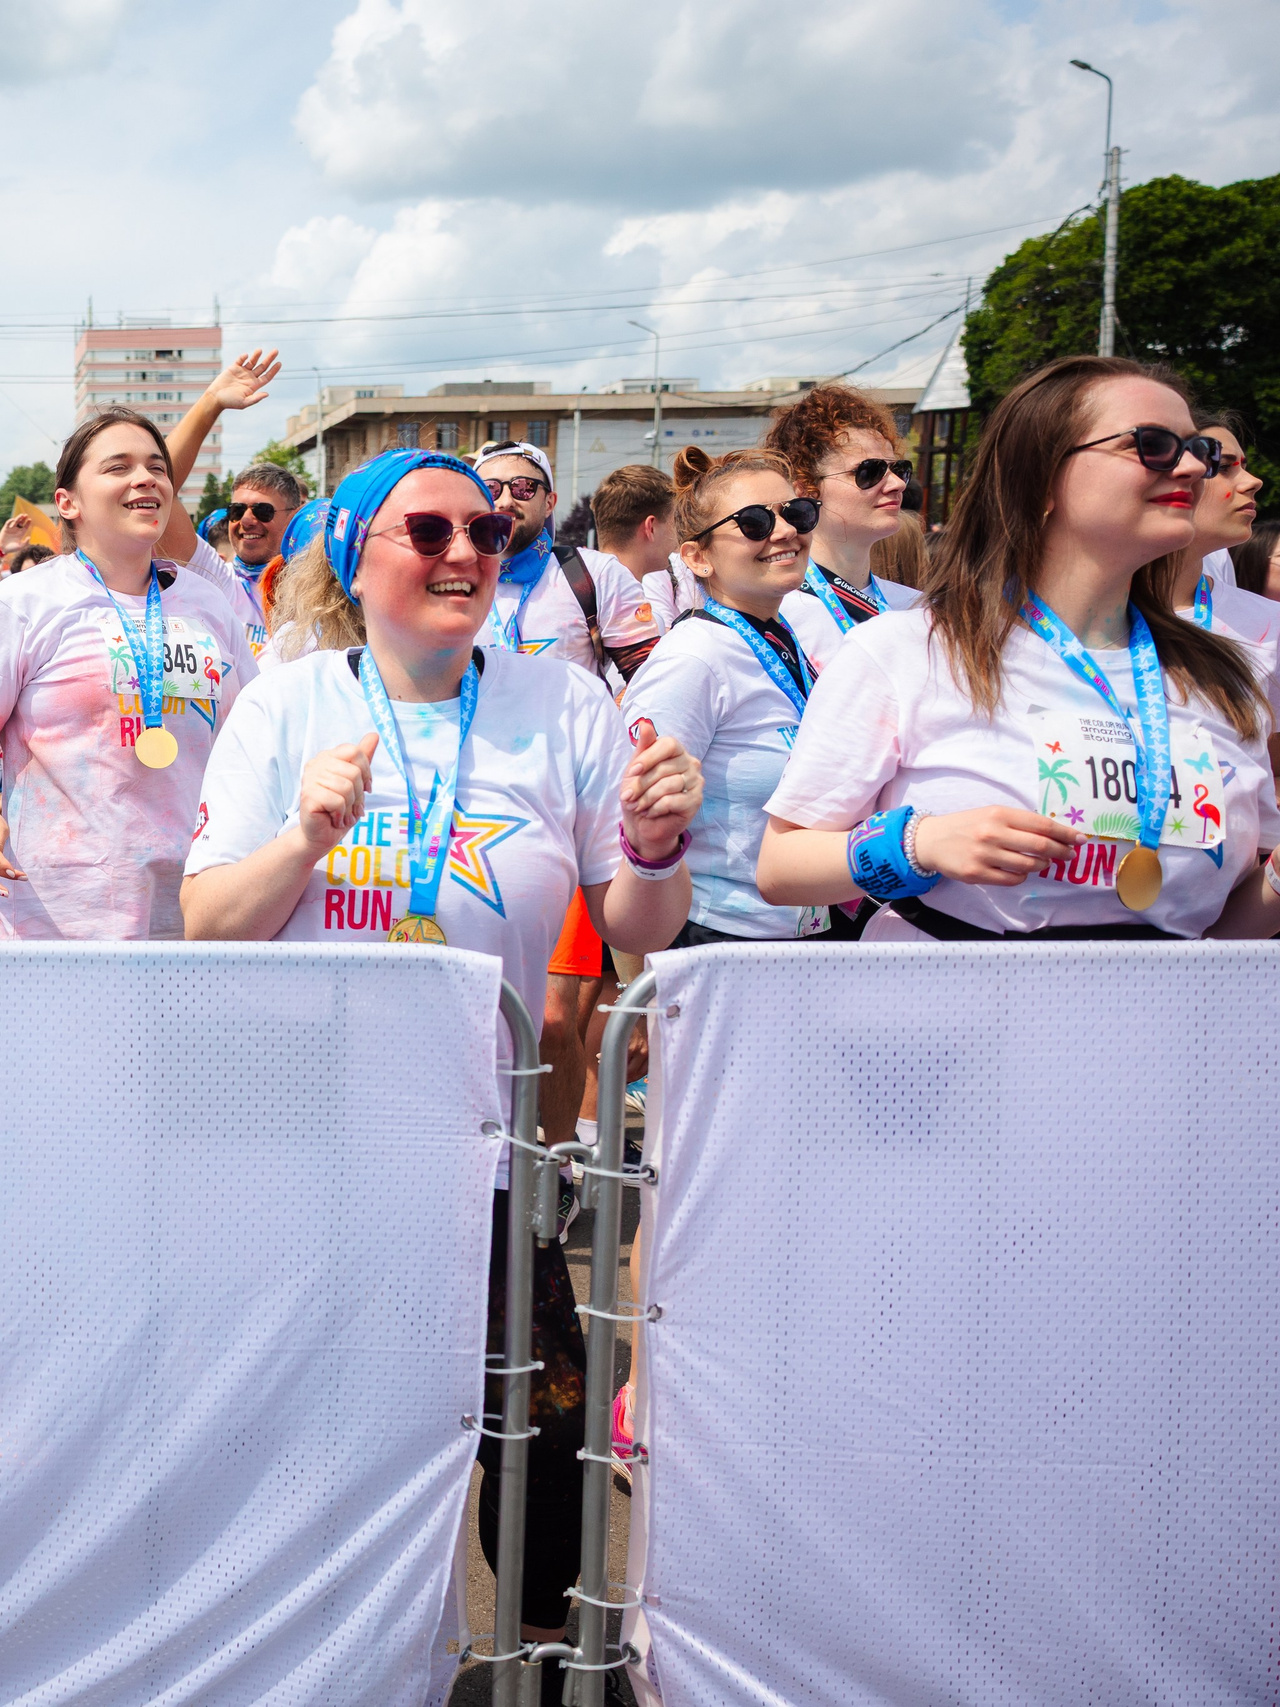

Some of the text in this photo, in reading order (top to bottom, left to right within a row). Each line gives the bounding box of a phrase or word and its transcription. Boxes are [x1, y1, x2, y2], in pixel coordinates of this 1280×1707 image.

[326, 505, 339, 532] THE
[841, 581, 867, 600] UniCredit
[246, 622, 268, 644] THE
[163, 643, 197, 674] 345
[1094, 675, 1110, 696] COLOR
[1078, 718, 1091, 726] THE
[1092, 719, 1115, 728] COLOR
[1081, 726, 1132, 739] amazing
[1090, 734, 1113, 743] tour
[1085, 756, 1182, 809] 1804
[339, 812, 393, 847] HE
[428, 835, 441, 857] COLOR
[326, 845, 411, 889] COLO
[425, 856, 437, 870] THE
[859, 849, 892, 895] COLOR
[876, 862, 906, 889] RUN
[324, 889, 393, 931] RUN
